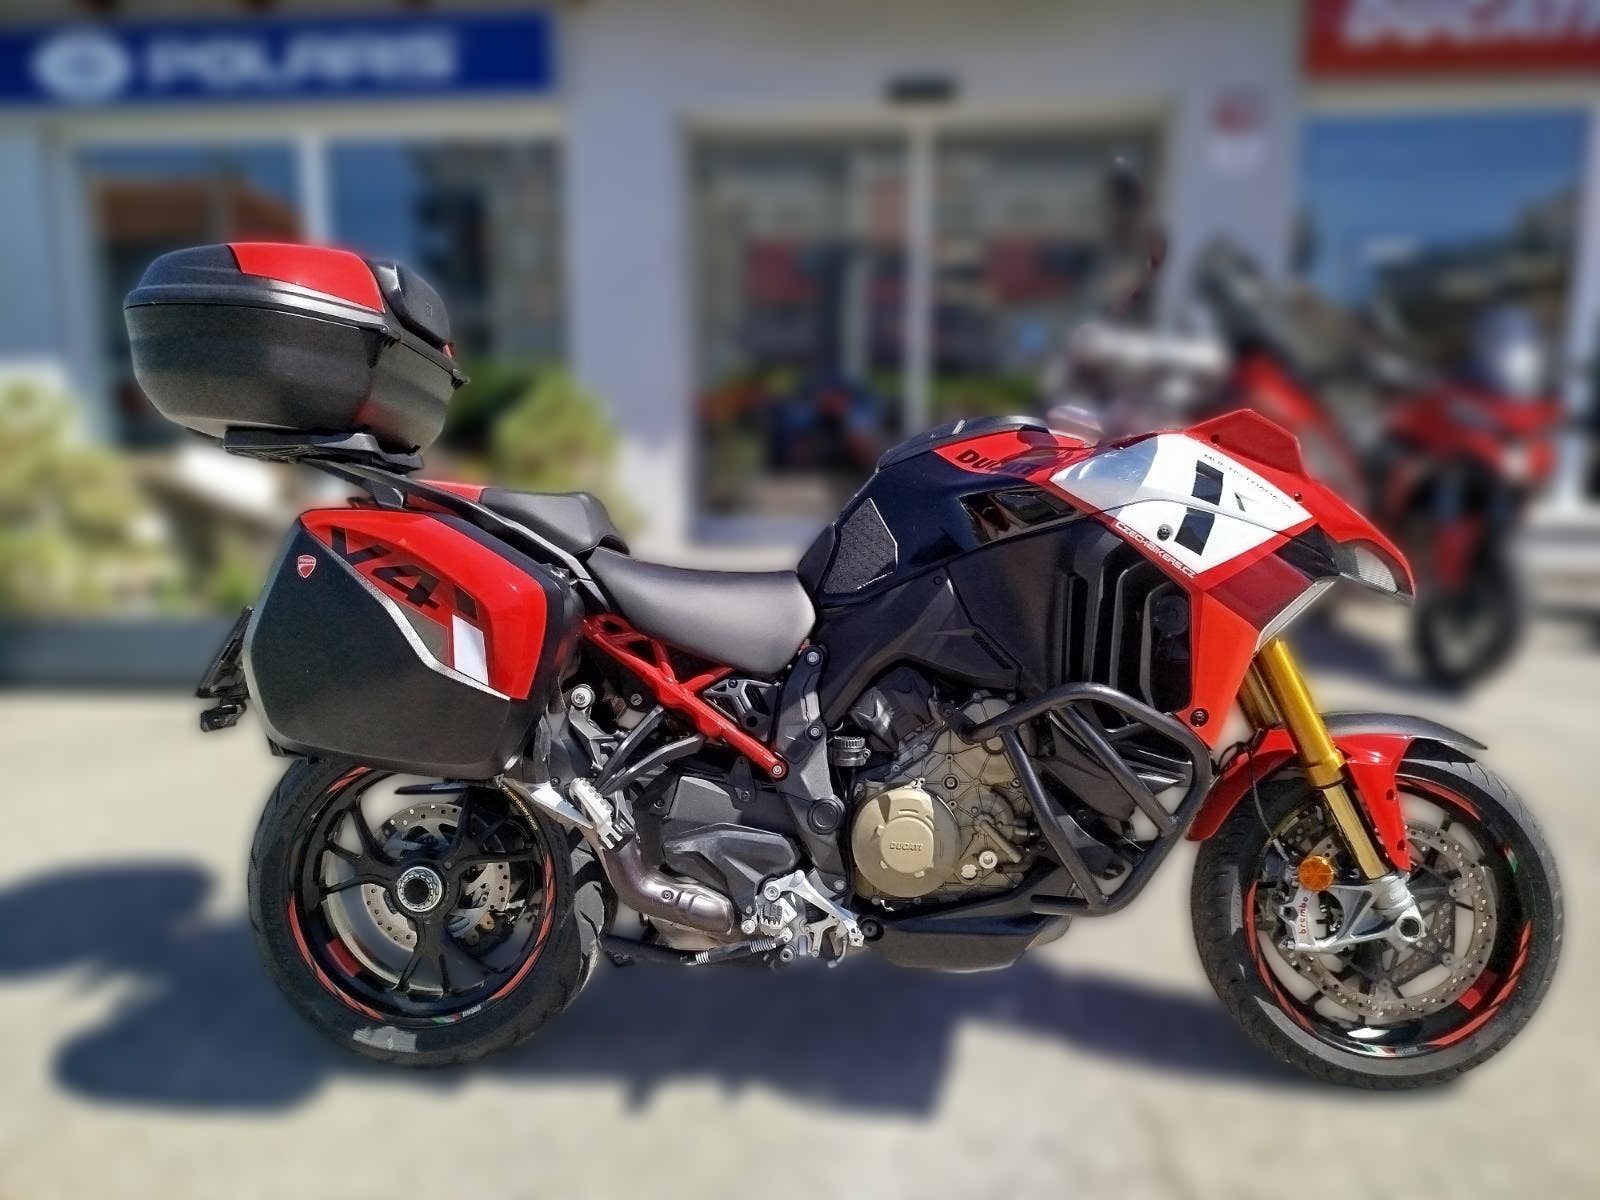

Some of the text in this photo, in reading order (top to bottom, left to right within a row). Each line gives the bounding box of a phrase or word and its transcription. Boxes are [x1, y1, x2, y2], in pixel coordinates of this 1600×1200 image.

[148, 34, 455, 88] POLARIS
[889, 841, 921, 852] DUCATI
[1298, 896, 1309, 935] brembo
